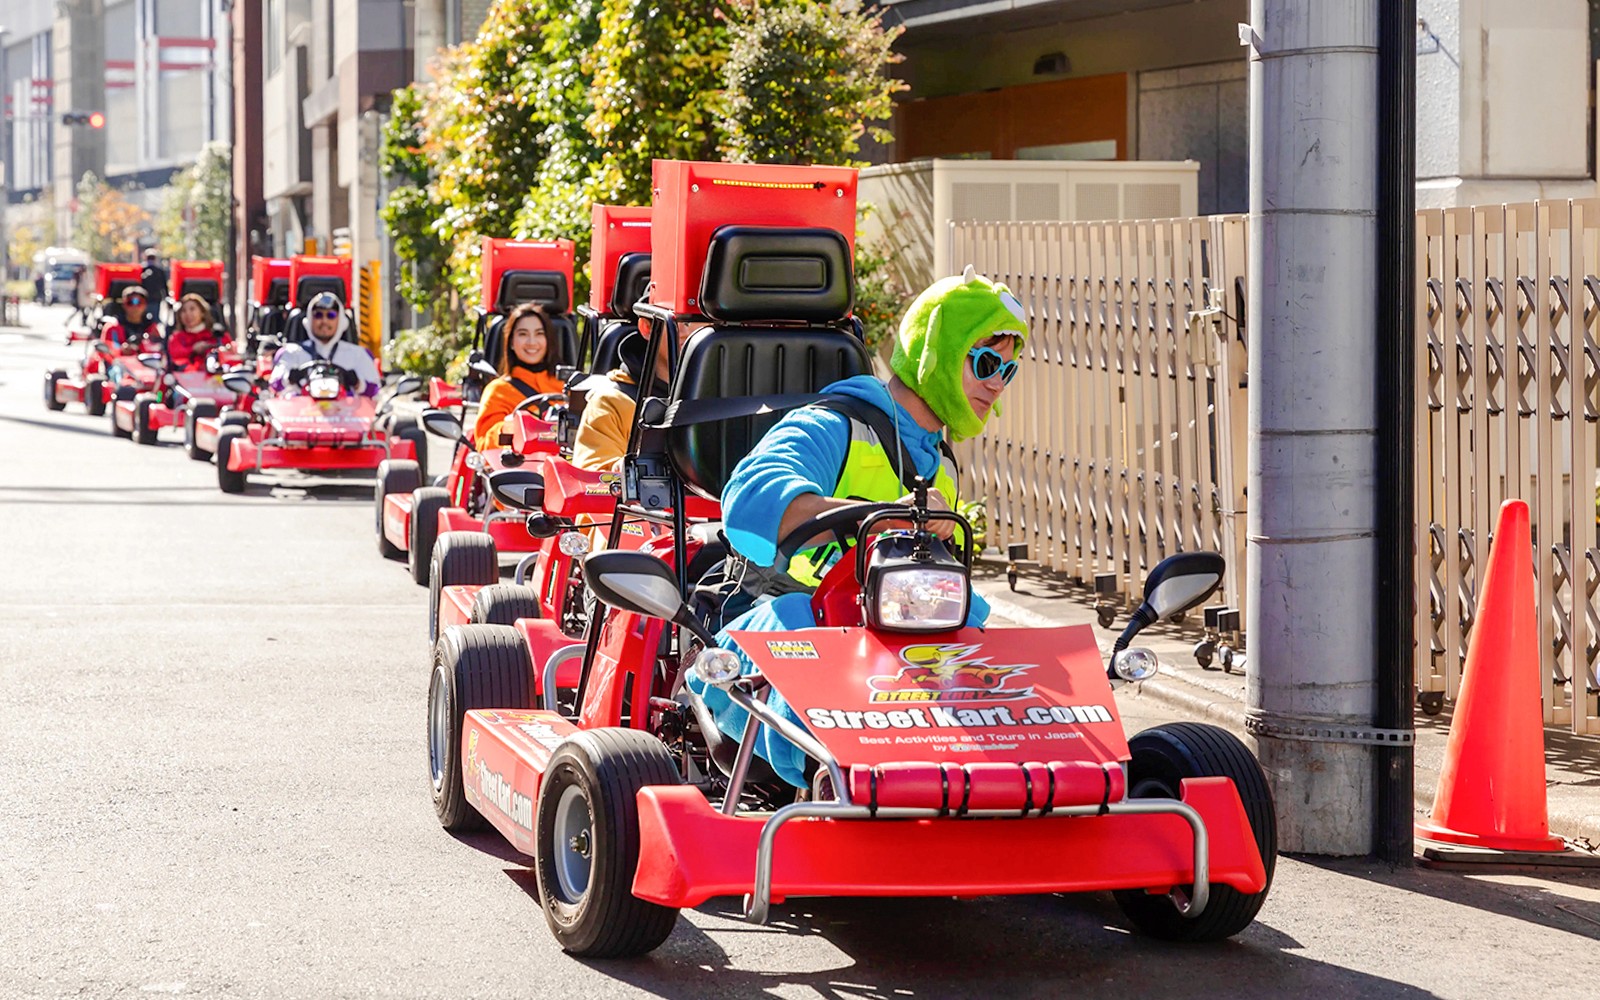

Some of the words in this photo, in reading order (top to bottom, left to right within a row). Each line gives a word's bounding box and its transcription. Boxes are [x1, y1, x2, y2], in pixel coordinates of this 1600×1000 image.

[805, 707, 932, 729] Street
[928, 705, 1018, 727] Kart
[1022, 704, 1113, 725] .com
[859, 736, 892, 744] Best
[895, 734, 956, 744] Activities
[960, 733, 984, 743] and
[987, 732, 1025, 742] Tours
[1044, 731, 1084, 741] Japan
[932, 744, 947, 752] by
[480, 758, 499, 807] Street
[497, 772, 511, 817] Kart
